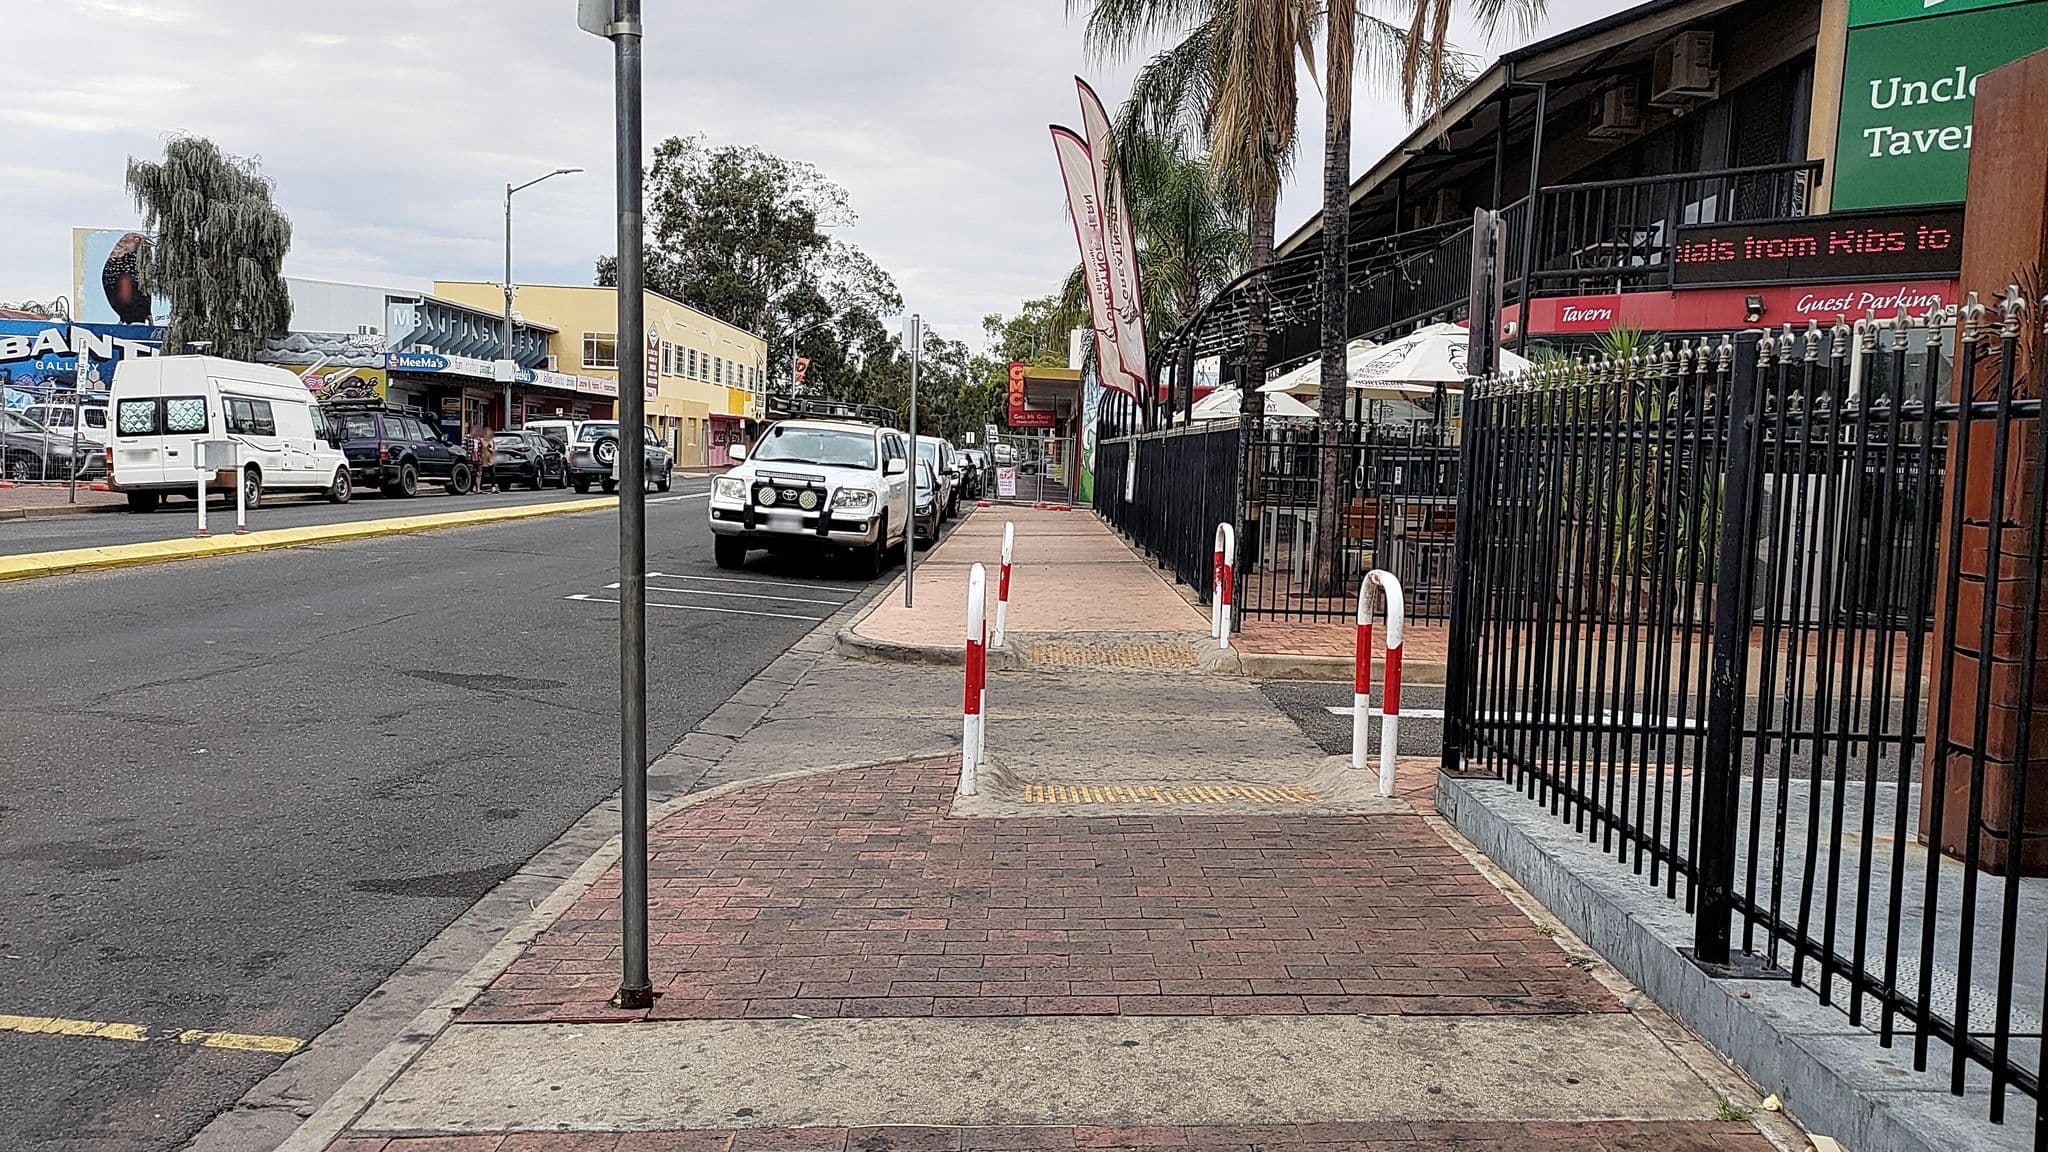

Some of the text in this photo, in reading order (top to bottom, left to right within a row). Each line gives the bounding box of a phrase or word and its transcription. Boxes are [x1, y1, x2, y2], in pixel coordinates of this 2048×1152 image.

[1745, 236, 1817, 259] from
[1917, 226, 1951, 250] to
[1796, 287, 1941, 316] Guest Parking
[1563, 306, 1612, 322] Tavern
[400, 357, 444, 368] MeeMa's
